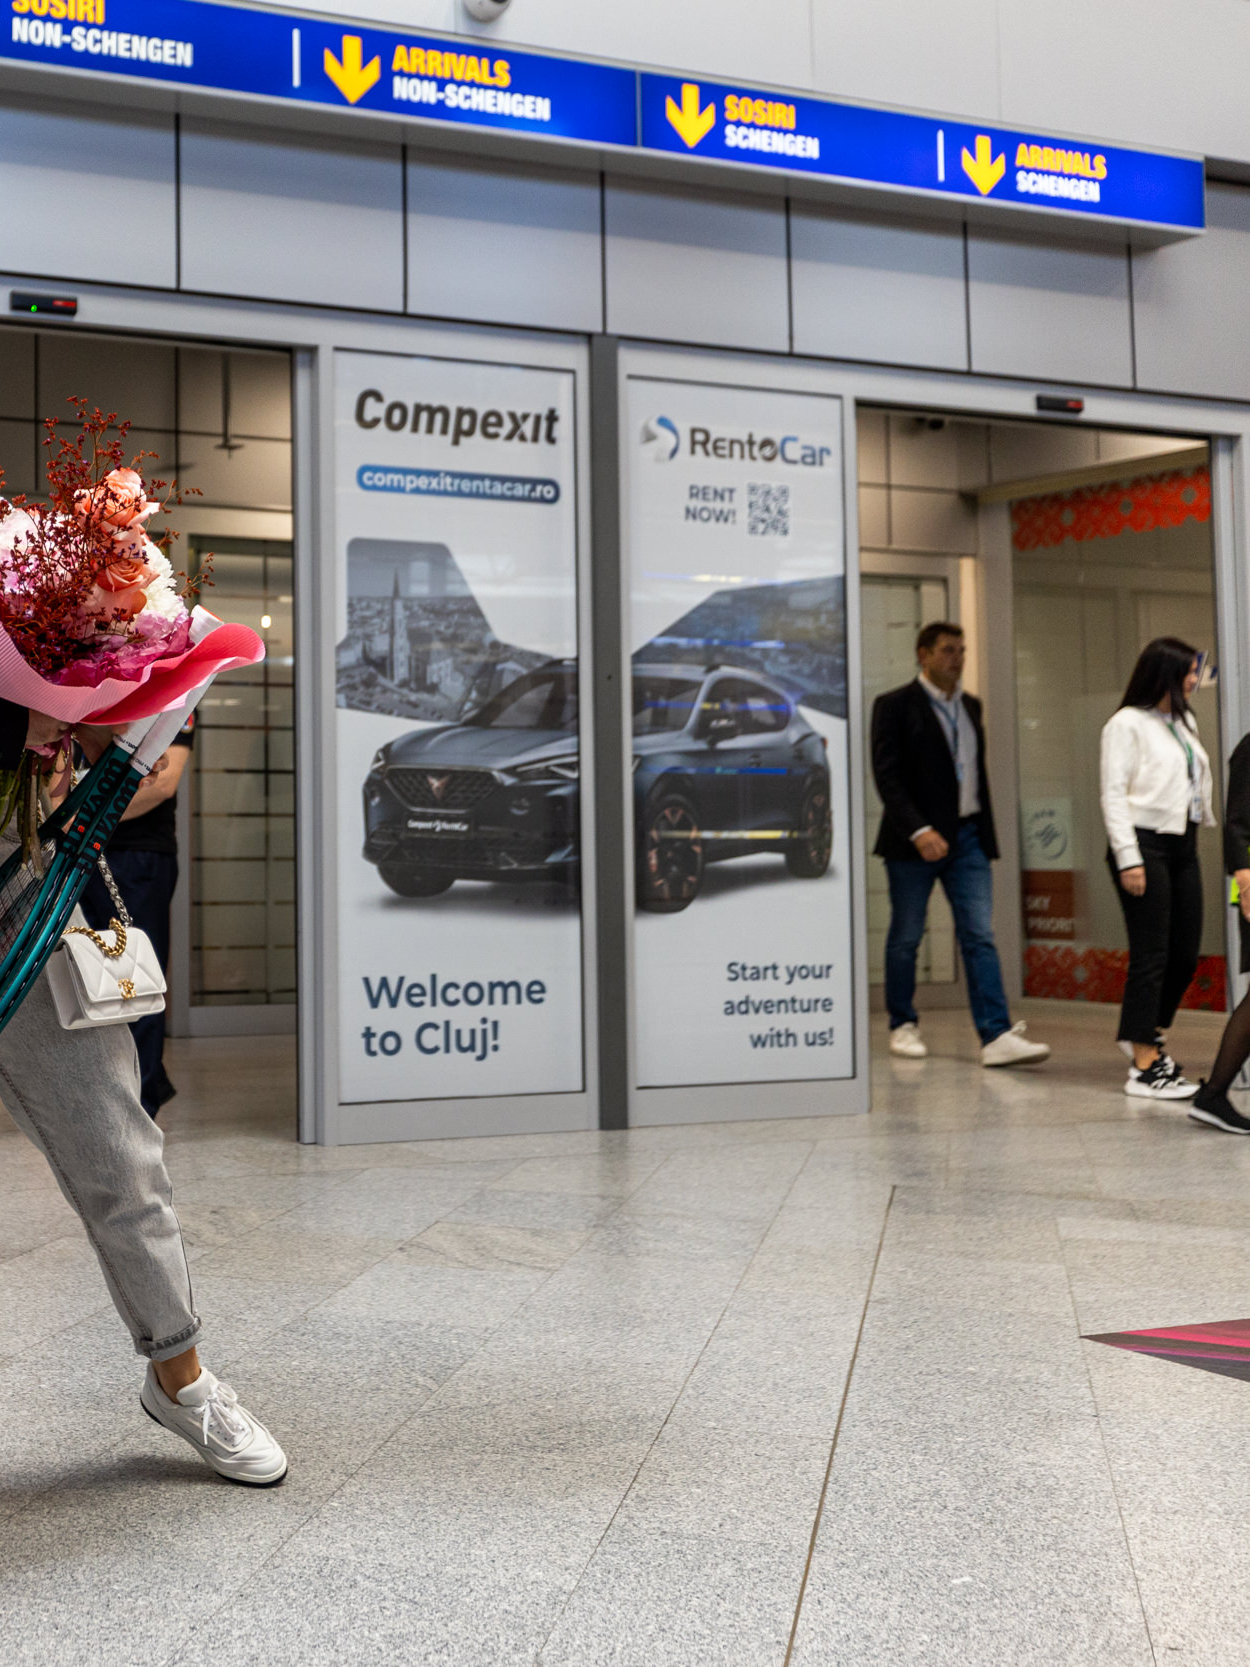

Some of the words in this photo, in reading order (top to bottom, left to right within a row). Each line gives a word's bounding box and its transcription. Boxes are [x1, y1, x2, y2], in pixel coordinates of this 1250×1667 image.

[11, 16, 193, 68] NON-SCHENGEN
[392, 45, 511, 88] ARRIVALS
[393, 75, 551, 122] NON-SCHENGEN
[724, 94, 796, 130] SOSIRI
[724, 123, 820, 160] SCHENGEN
[1015, 143, 1107, 179] ARRIVALS
[1015, 170, 1100, 203] SCHENGEN
[354, 388, 559, 446] Compexit
[689, 427, 831, 467] RentoCar
[362, 468, 556, 500] compexitrentacar.ro
[688, 485, 736, 502] RENT
[685, 505, 737, 524] NOW!
[362, 973, 547, 1010] Welcome
[727, 962, 780, 982] Start
[785, 964, 833, 986] your
[723, 994, 834, 1016] adventure
[361, 1026, 403, 1057] to
[415, 1017, 500, 1062] Cluj!
[750, 1027, 798, 1049] with
[804, 1027, 835, 1047] us!
